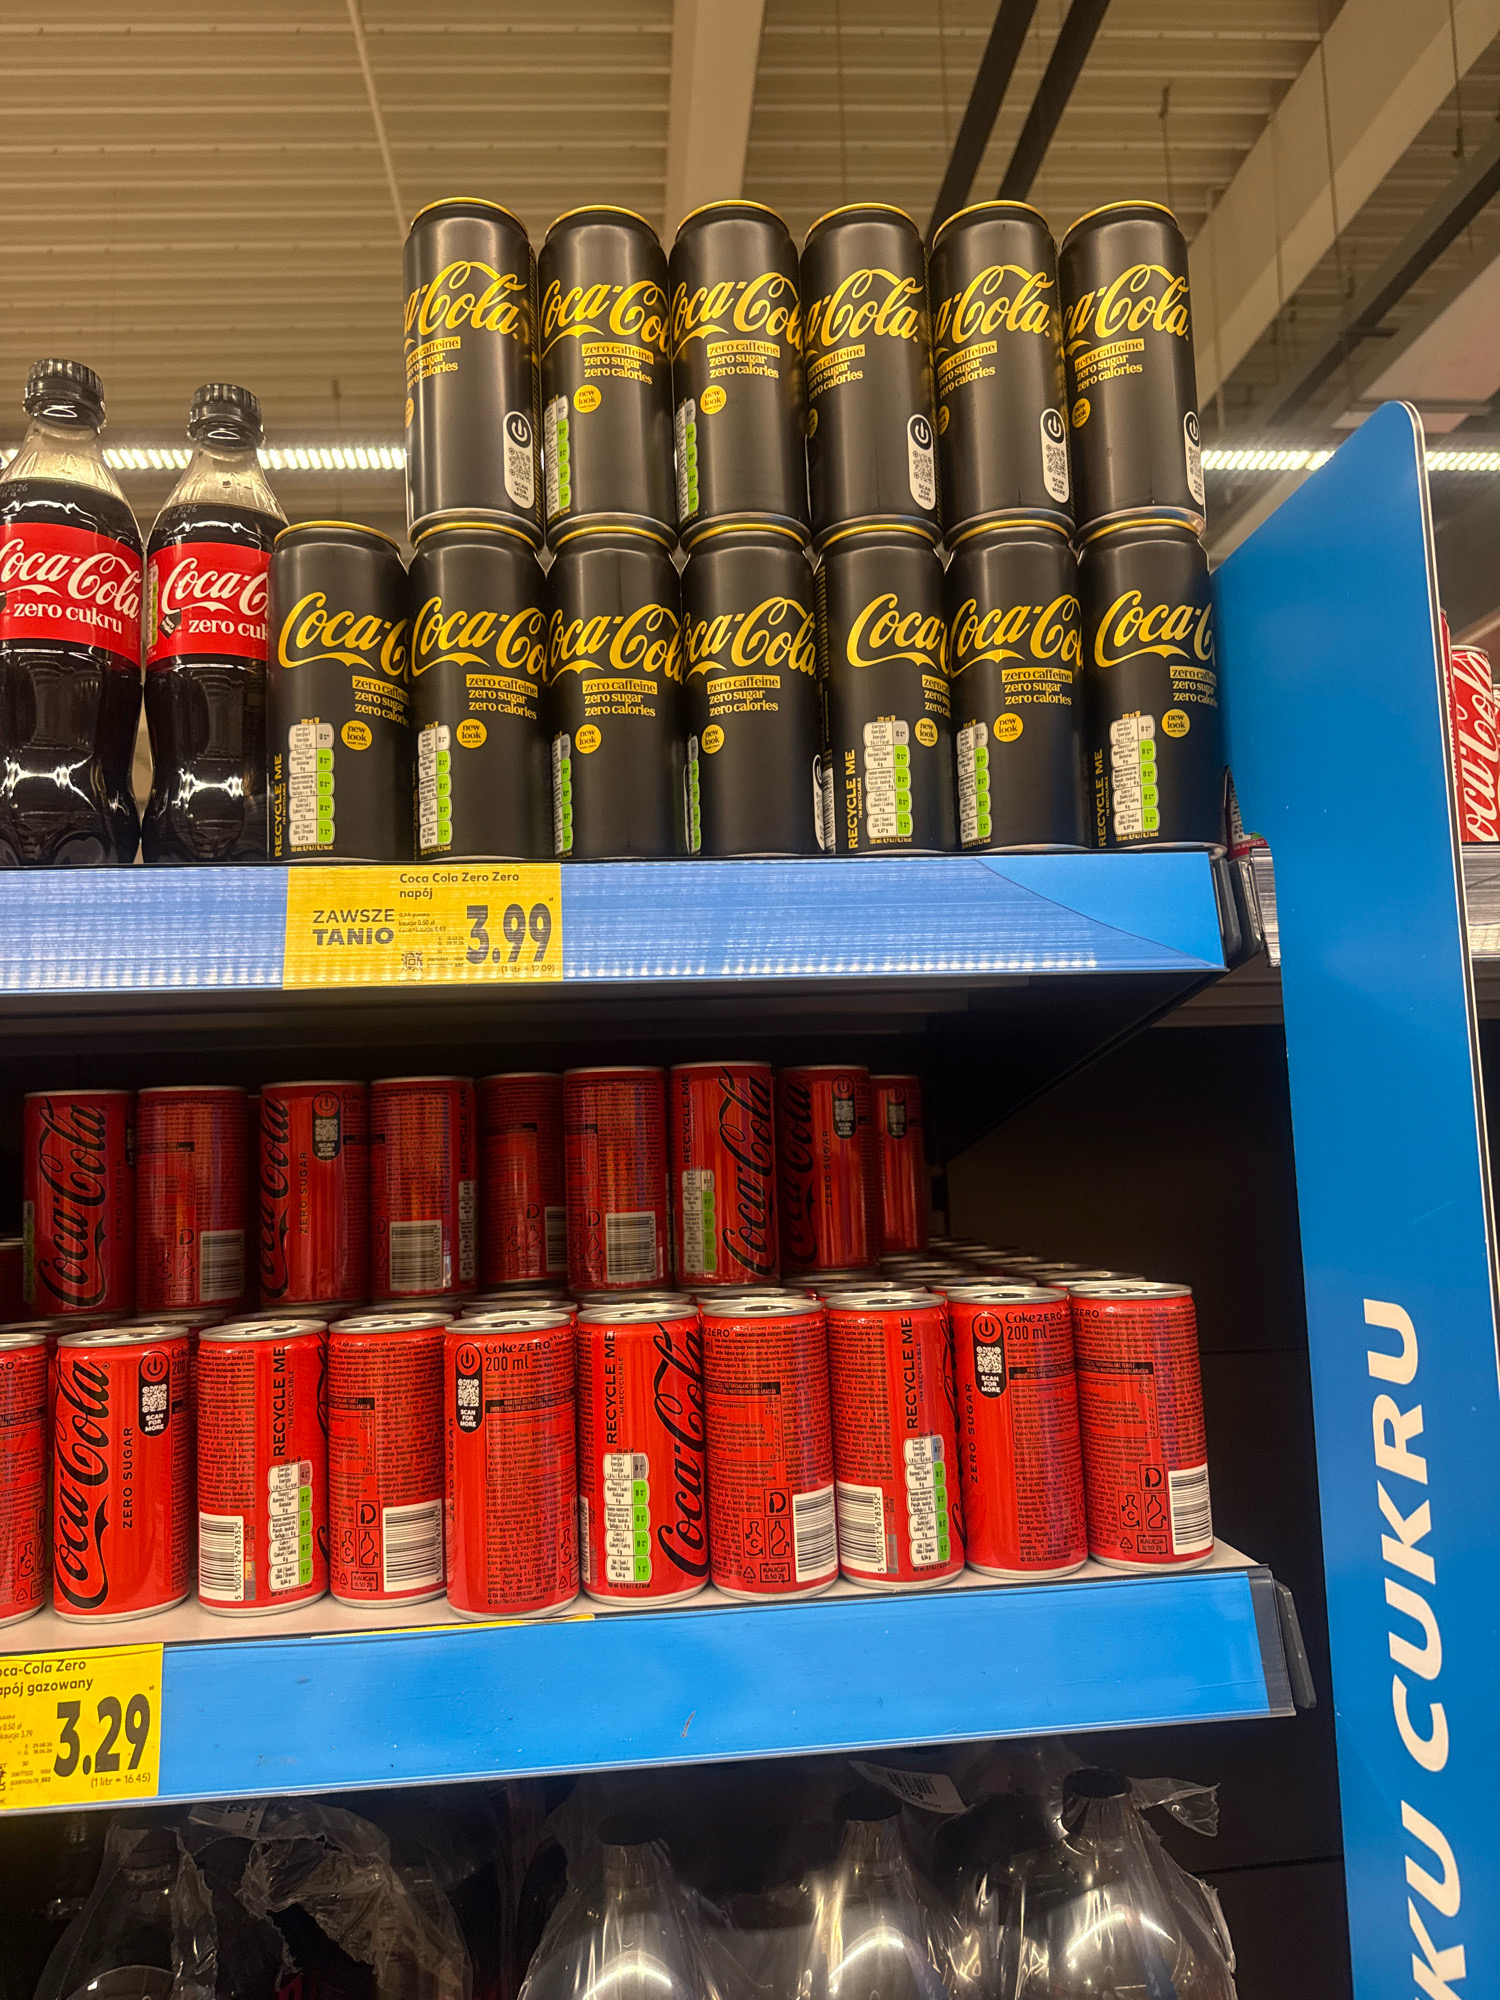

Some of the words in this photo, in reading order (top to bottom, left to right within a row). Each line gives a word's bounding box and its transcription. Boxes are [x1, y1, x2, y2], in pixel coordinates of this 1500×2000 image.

[404, 261, 528, 336] a-Cola
[934, 264, 1055, 346] a-Cola
[804, 268, 924, 347] a-Cola
[583, 345, 610, 355] zero
[611, 344, 653, 362] caffeine
[708, 344, 734, 355] zero
[735, 342, 779, 356] caffeine
[584, 356, 610, 366] zero
[611, 356, 642, 369] sugar
[709, 355, 735, 367] zero
[736, 355, 767, 365] sugar
[1097, 354, 1129, 370] sugar
[584, 367, 610, 378] zero
[611, 365, 653, 384] calories
[709, 366, 735, 379] zero
[736, 363, 779, 379] calories
[1098, 363, 1143, 381] calories
[161, 558, 268, 619] Coca-C
[13, 602, 63, 618] zero
[65, 606, 122, 634] cukru
[188, 619, 235, 635] zero
[1094, 590, 1216, 668] Coca-C
[278, 592, 409, 684] Coca-C
[708, 681, 732, 693] zero
[733, 676, 778, 688] caffeine
[1003, 671, 1031, 681] zero
[1032, 670, 1072, 682] caffeine
[468, 677, 496, 687] zero
[497, 677, 537, 697] caffeine
[584, 681, 610, 692] zero
[611, 680, 656, 693] caffeine
[1004, 683, 1031, 693] zero
[1032, 683, 1062, 693] sugar
[468, 689, 496, 699] zero
[497, 690, 527, 704] sugar
[584, 693, 611, 705] zero
[611, 693, 644, 705] sugar
[708, 692, 732, 705] zero
[733, 690, 766, 701] sugar
[1004, 695, 1032, 705] zero
[1033, 692, 1072, 706] calories
[468, 701, 497, 711] zero
[497, 700, 537, 720] calories
[584, 705, 611, 717] zero
[611, 701, 656, 717] calories
[709, 704, 733, 717] zero
[733, 700, 779, 712] calories
[347, 725, 366, 734] new
[998, 725, 1018, 734] look
[999, 717, 1017, 726] new
[1167, 720, 1186, 729] look
[347, 732, 367, 742] look
[462, 730, 482, 740] look
[579, 729, 595, 738] new
[579, 736, 596, 746] look
[704, 736, 720, 747] look
[705, 729, 719, 738] new
[274, 753, 283, 780] ME
[844, 749, 856, 775] ME
[274, 783, 283, 857] RECYCLE
[845, 778, 859, 849] RECYCLE
[399, 873, 429, 884] Coca
[432, 872, 459, 883] Cola
[462, 871, 489, 882] Zero
[492, 871, 520, 882] Zero
[399, 886, 433, 900] napój
[312, 908, 395, 924] ZAWSZE
[312, 927, 395, 946] TANIO
[466, 903, 552, 964] 3.99
[901, 1316, 914, 1345] ME
[1006, 1325, 1029, 1340] 200
[1033, 1325, 1047, 1339] ml
[604, 1331, 616, 1360] ME
[273, 1346, 286, 1373] ME
[485, 1355, 508, 1372] 200
[512, 1354, 530, 1370] ml
[903, 1349, 919, 1430] RECYCLE
[604, 1363, 618, 1445] RECYCLE
[965, 1383, 976, 1436] SUGAR
[145, 1413, 164, 1422] SCAN
[147, 1419, 162, 1427] FOR
[273, 1378, 286, 1457] RECYCLE
[144, 1424, 165, 1433] MORE
[122, 1427, 133, 1481] SUGAR
[968, 1440, 979, 1484] ZERO
[122, 1484, 133, 1529] ZERO
[1363, 1297, 1449, 1772] CUKRU
[56, 1659, 86, 1672] Zero
[27, 1679, 94, 1697] gazowany
[53, 1693, 151, 1778] 3.29
[99, 1776, 113, 1787] litr
[124, 1772, 151, 1785] 16.45)
[1400, 1799, 1466, 2000] KU
